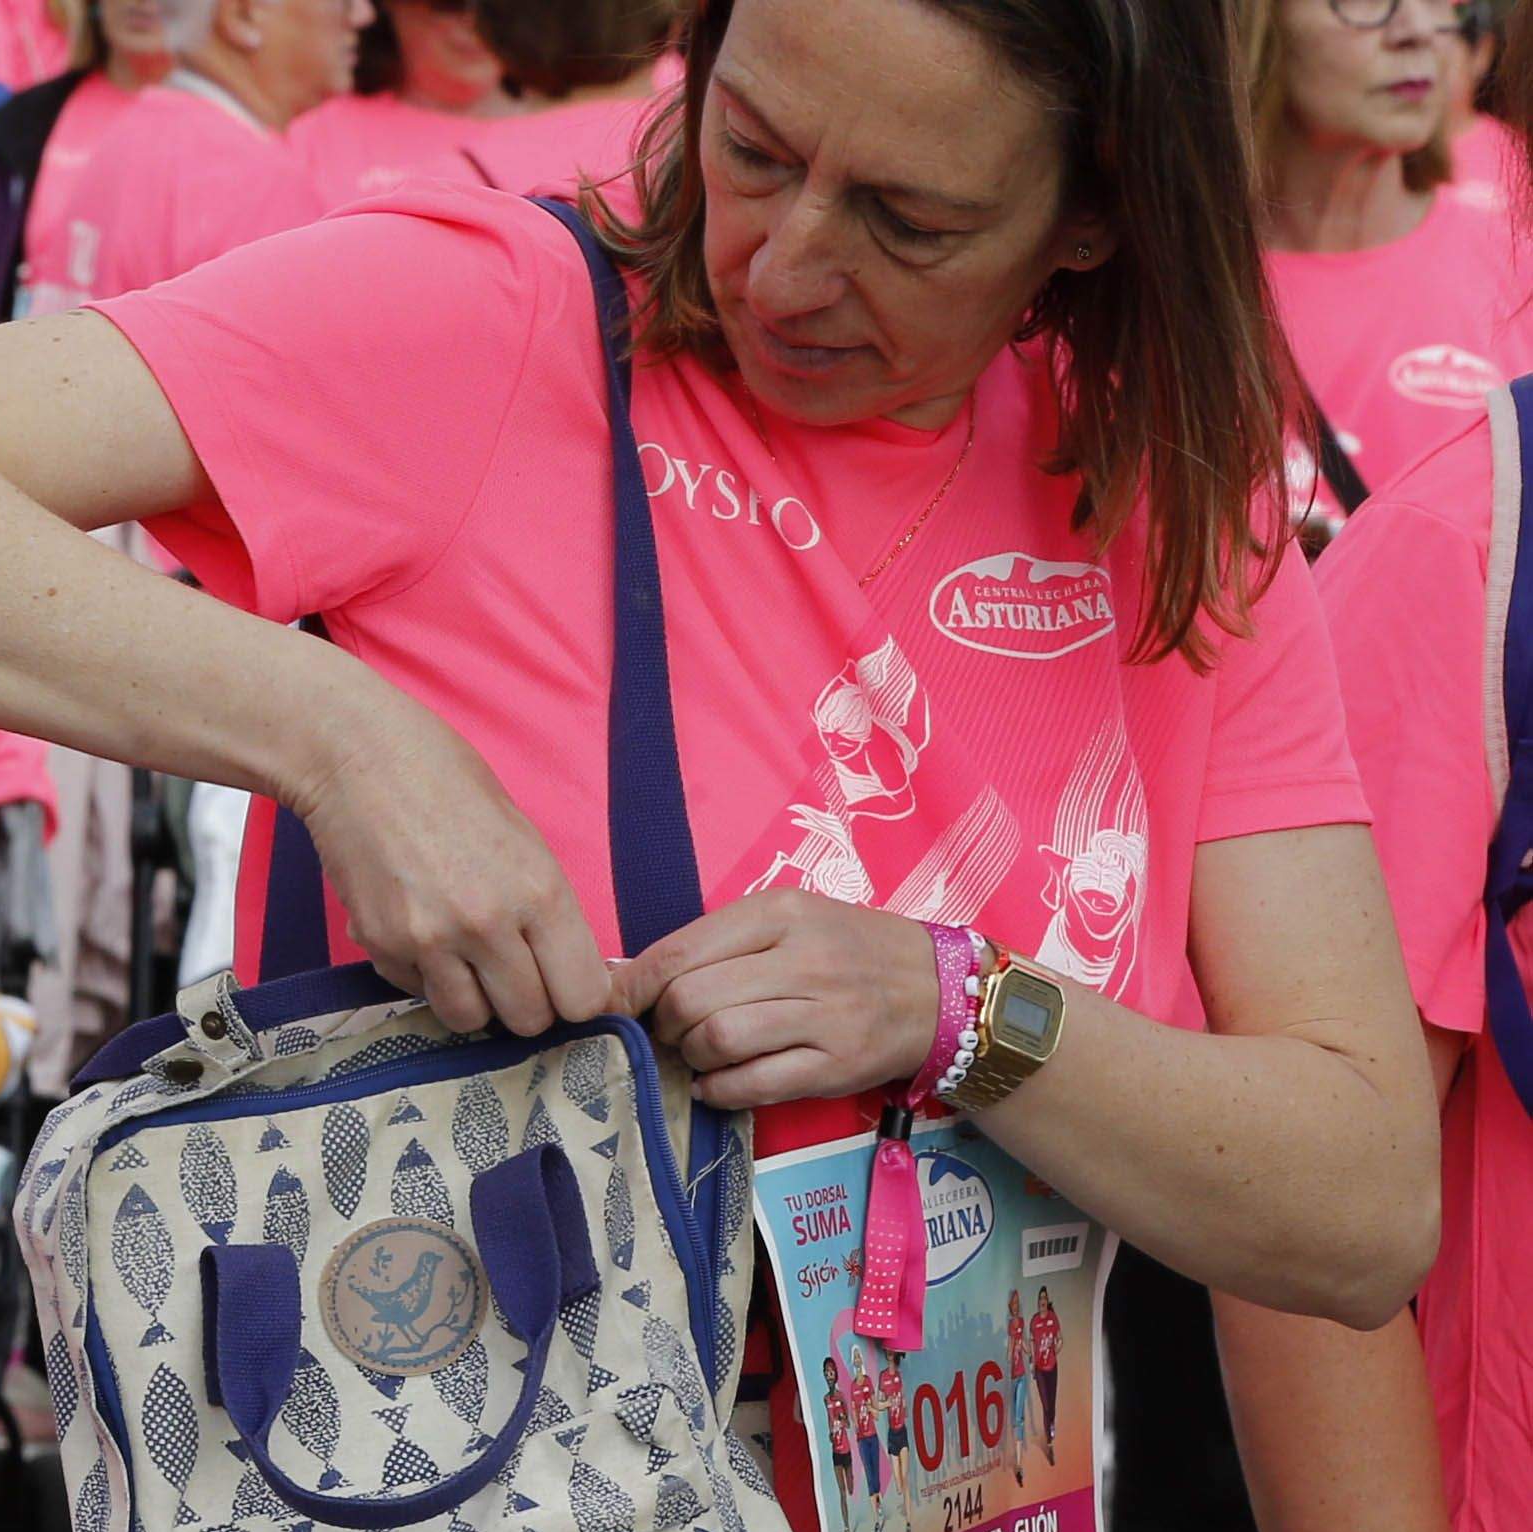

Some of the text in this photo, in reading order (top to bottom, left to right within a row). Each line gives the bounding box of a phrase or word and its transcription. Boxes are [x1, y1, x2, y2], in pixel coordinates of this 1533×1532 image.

[946, 587, 1113, 632] ASTURIANA
[975, 586, 1032, 599] CENTRAL
[784, 1184, 848, 1213] TU DORSAL
[793, 1205, 851, 1246] SUMA
[926, 1203, 987, 1249] RIANA
[912, 1359, 1005, 1473] 016
